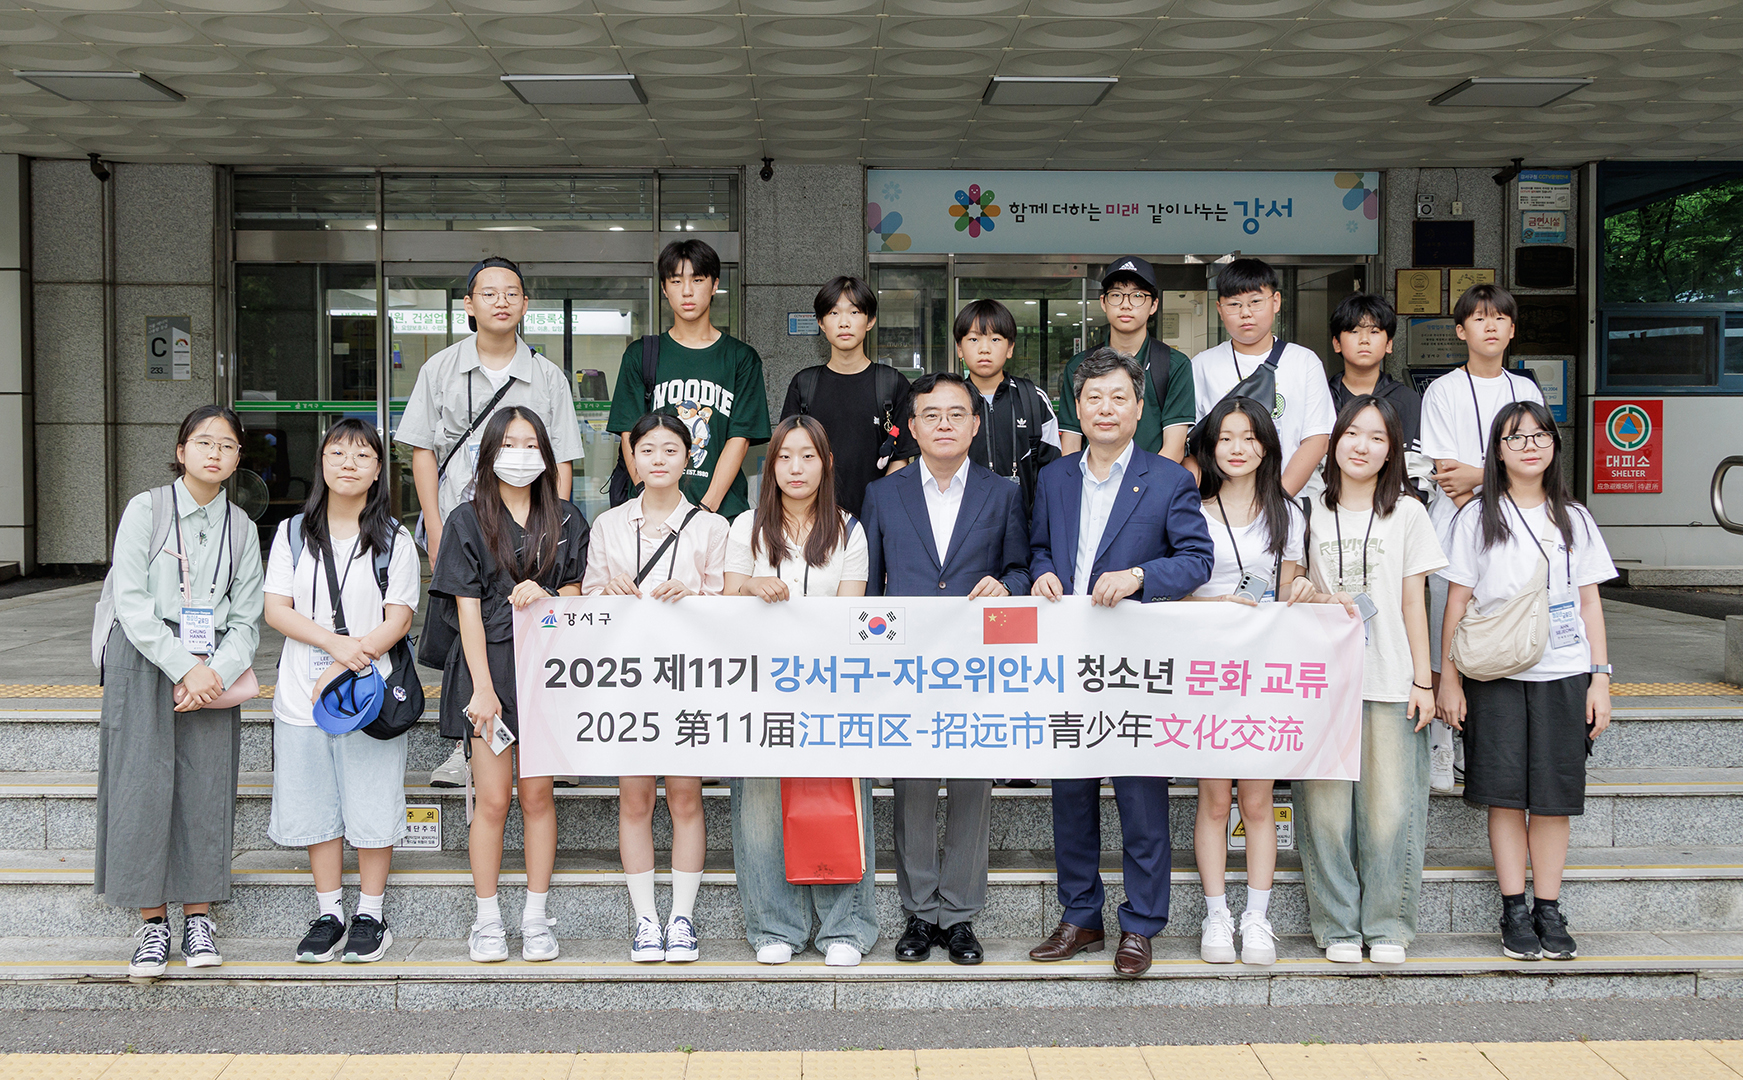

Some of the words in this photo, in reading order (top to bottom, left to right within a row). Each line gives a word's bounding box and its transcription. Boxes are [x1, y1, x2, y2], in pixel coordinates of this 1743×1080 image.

[1008, 202, 1048, 223] 함께
[1052, 202, 1102, 222] 더하는
[1105, 203, 1140, 217] 미래
[1147, 203, 1180, 224] 같이
[1183, 203, 1229, 222] 나누는
[1233, 197, 1293, 235] 강서
[1528, 213, 1561, 227] 금연시설
[412, 312, 466, 325] 건설업경
[151, 336, 167, 357] C
[150, 366, 163, 374] 233
[1606, 455, 1650, 468] 대피소
[1611, 469, 1646, 478] SHELTER
[1318, 537, 1386, 556] REVIVAL
[563, 612, 612, 627] 강서구
[544, 657, 642, 689] 2025
[652, 653, 758, 692] 제11기
[770, 654, 1064, 693] 강서구-자오위안시
[1077, 654, 1174, 695] 청소년
[1185, 659, 1252, 697] 문화
[1260, 661, 1329, 699] 교류
[576, 711, 661, 743] 2025
[674, 709, 1304, 752] 第11届江西区-招远市青少年文化交流
